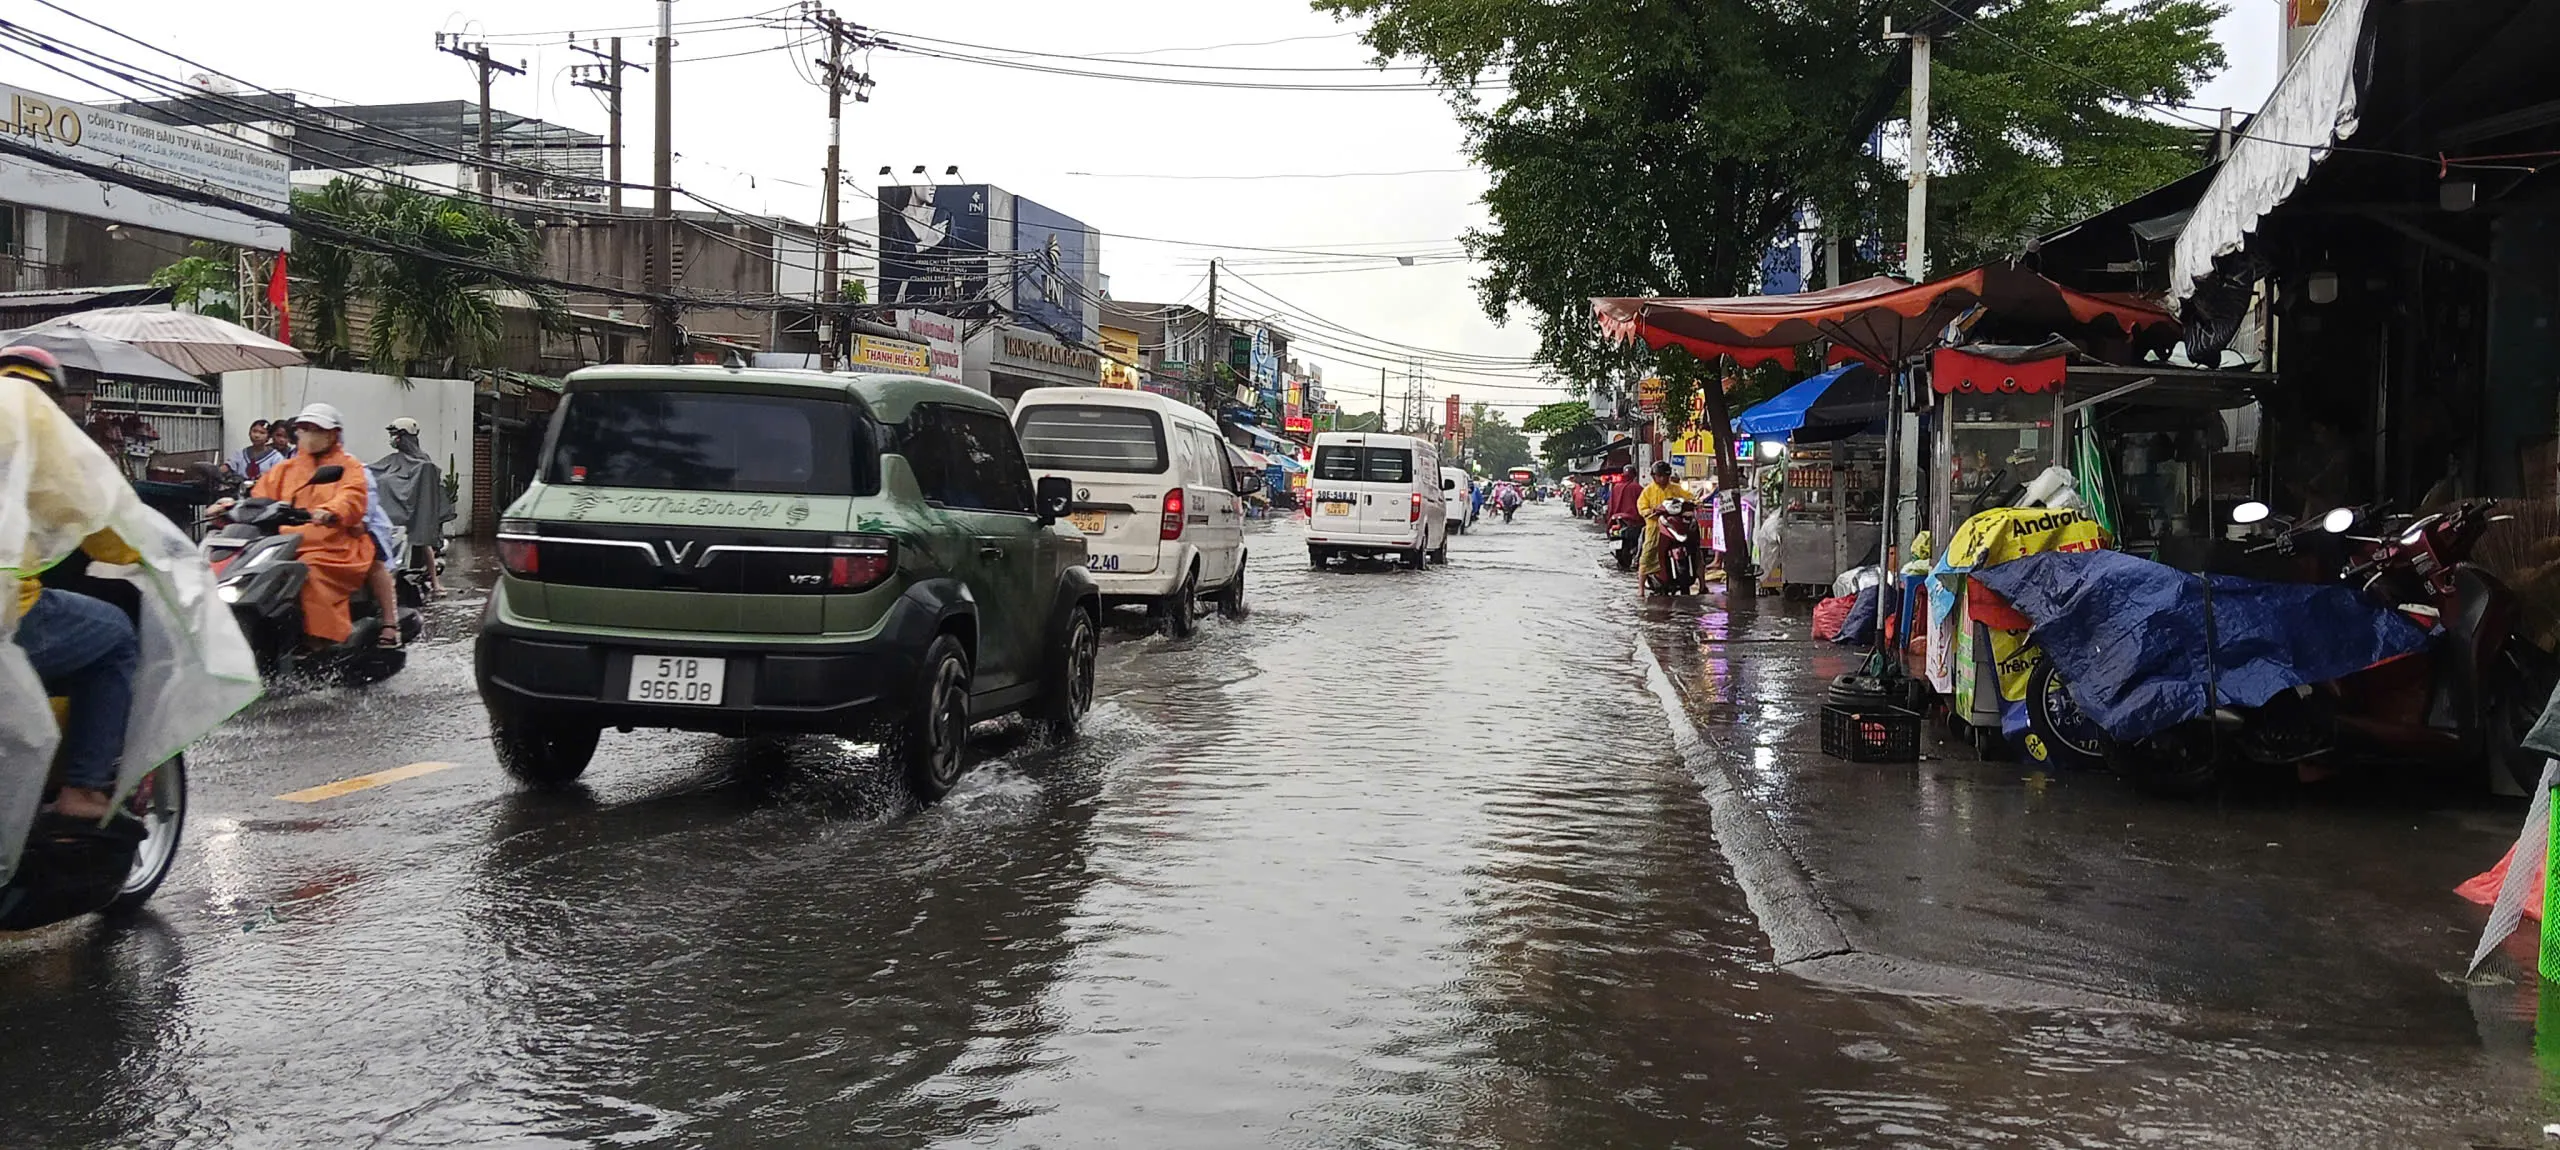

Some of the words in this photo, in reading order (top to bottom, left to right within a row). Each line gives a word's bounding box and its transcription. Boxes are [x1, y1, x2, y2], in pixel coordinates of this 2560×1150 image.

[87, 112, 114, 129] CÔNG
[116, 120, 128, 132] TY
[191, 138, 203, 152] VÀ
[969, 203, 984, 213] PNJ
[865, 349, 892, 362] THANH
[915, 357, 921, 367] 2
[658, 658, 697, 679] 51B
[1997, 659, 2029, 676] Trên
[640, 680, 712, 701] 966.08
